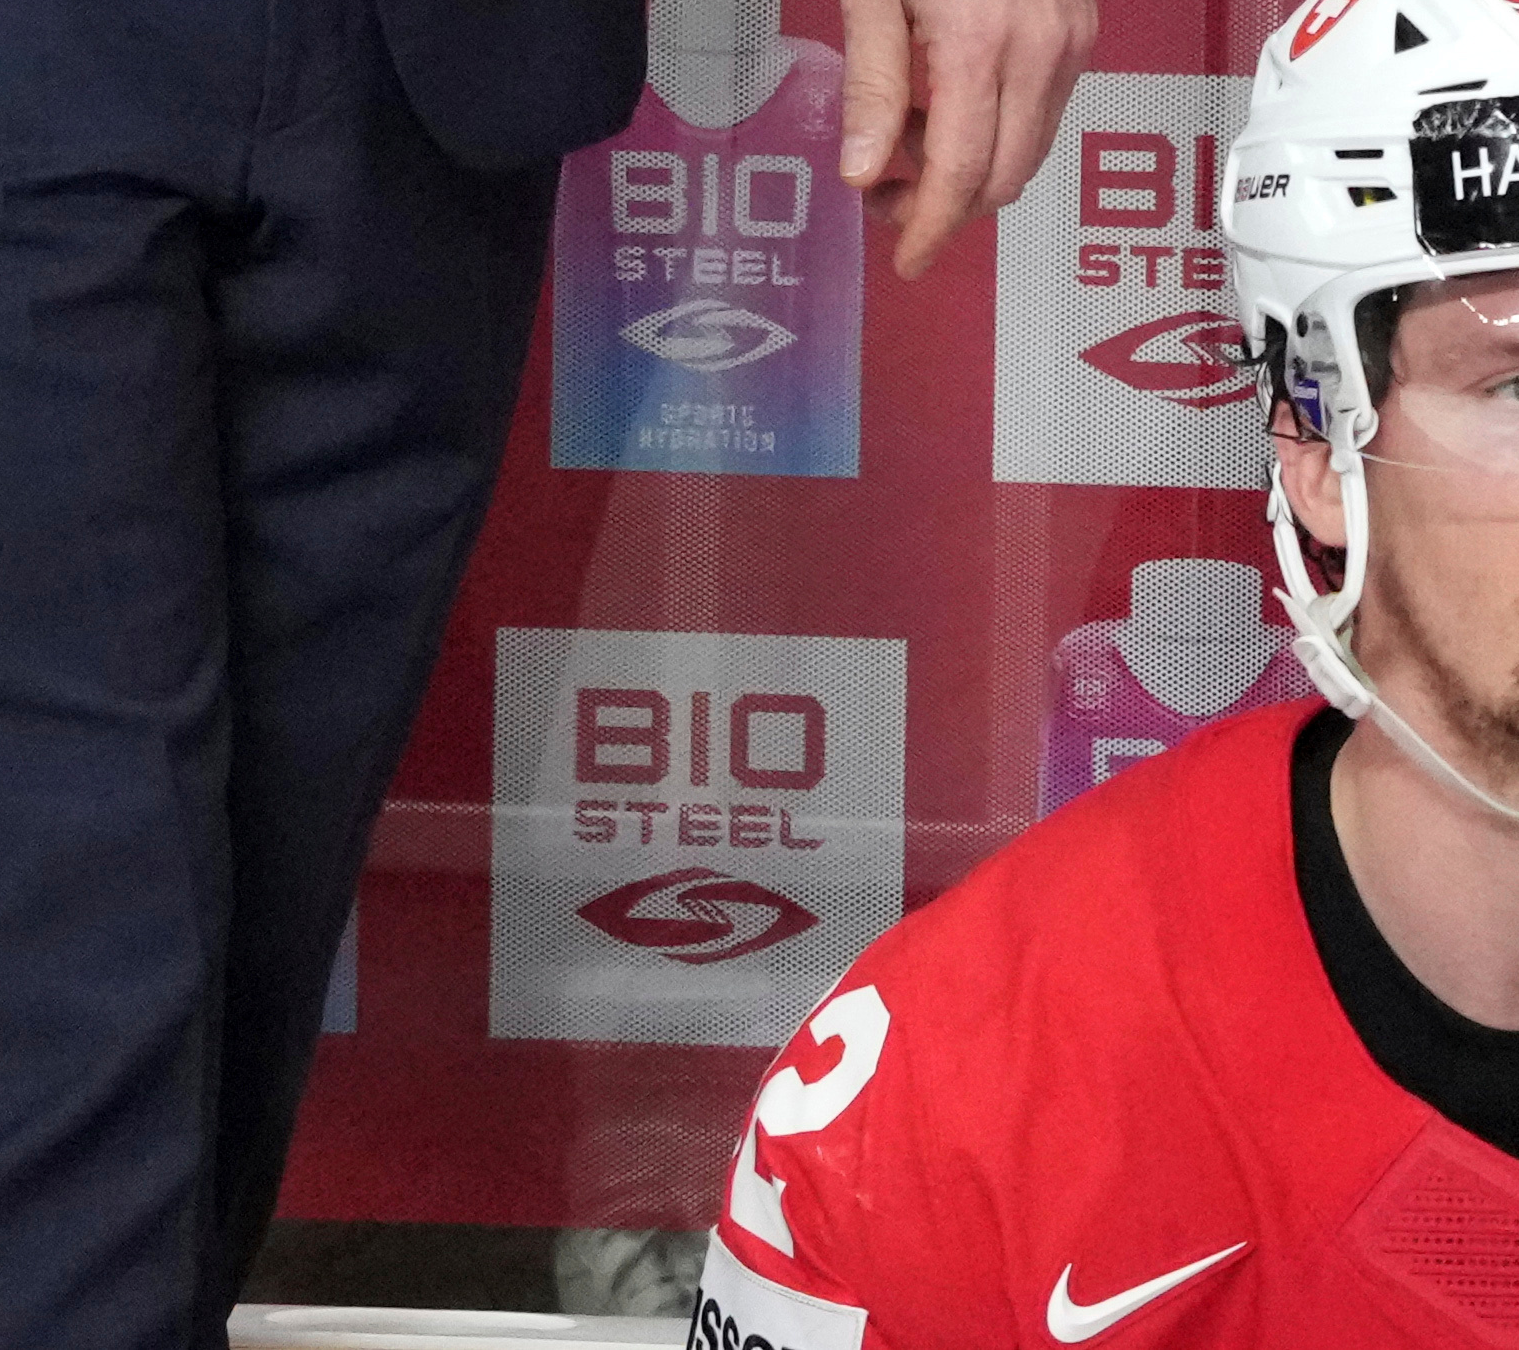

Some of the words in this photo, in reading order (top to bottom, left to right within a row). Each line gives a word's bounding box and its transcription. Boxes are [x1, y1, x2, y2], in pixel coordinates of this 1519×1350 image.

[612, 151, 812, 238] BIO
[1081, 132, 1221, 227] BI
[614, 247, 803, 285] STEEL
[575, 689, 825, 790] BIO
[573, 799, 823, 849] STEEL
